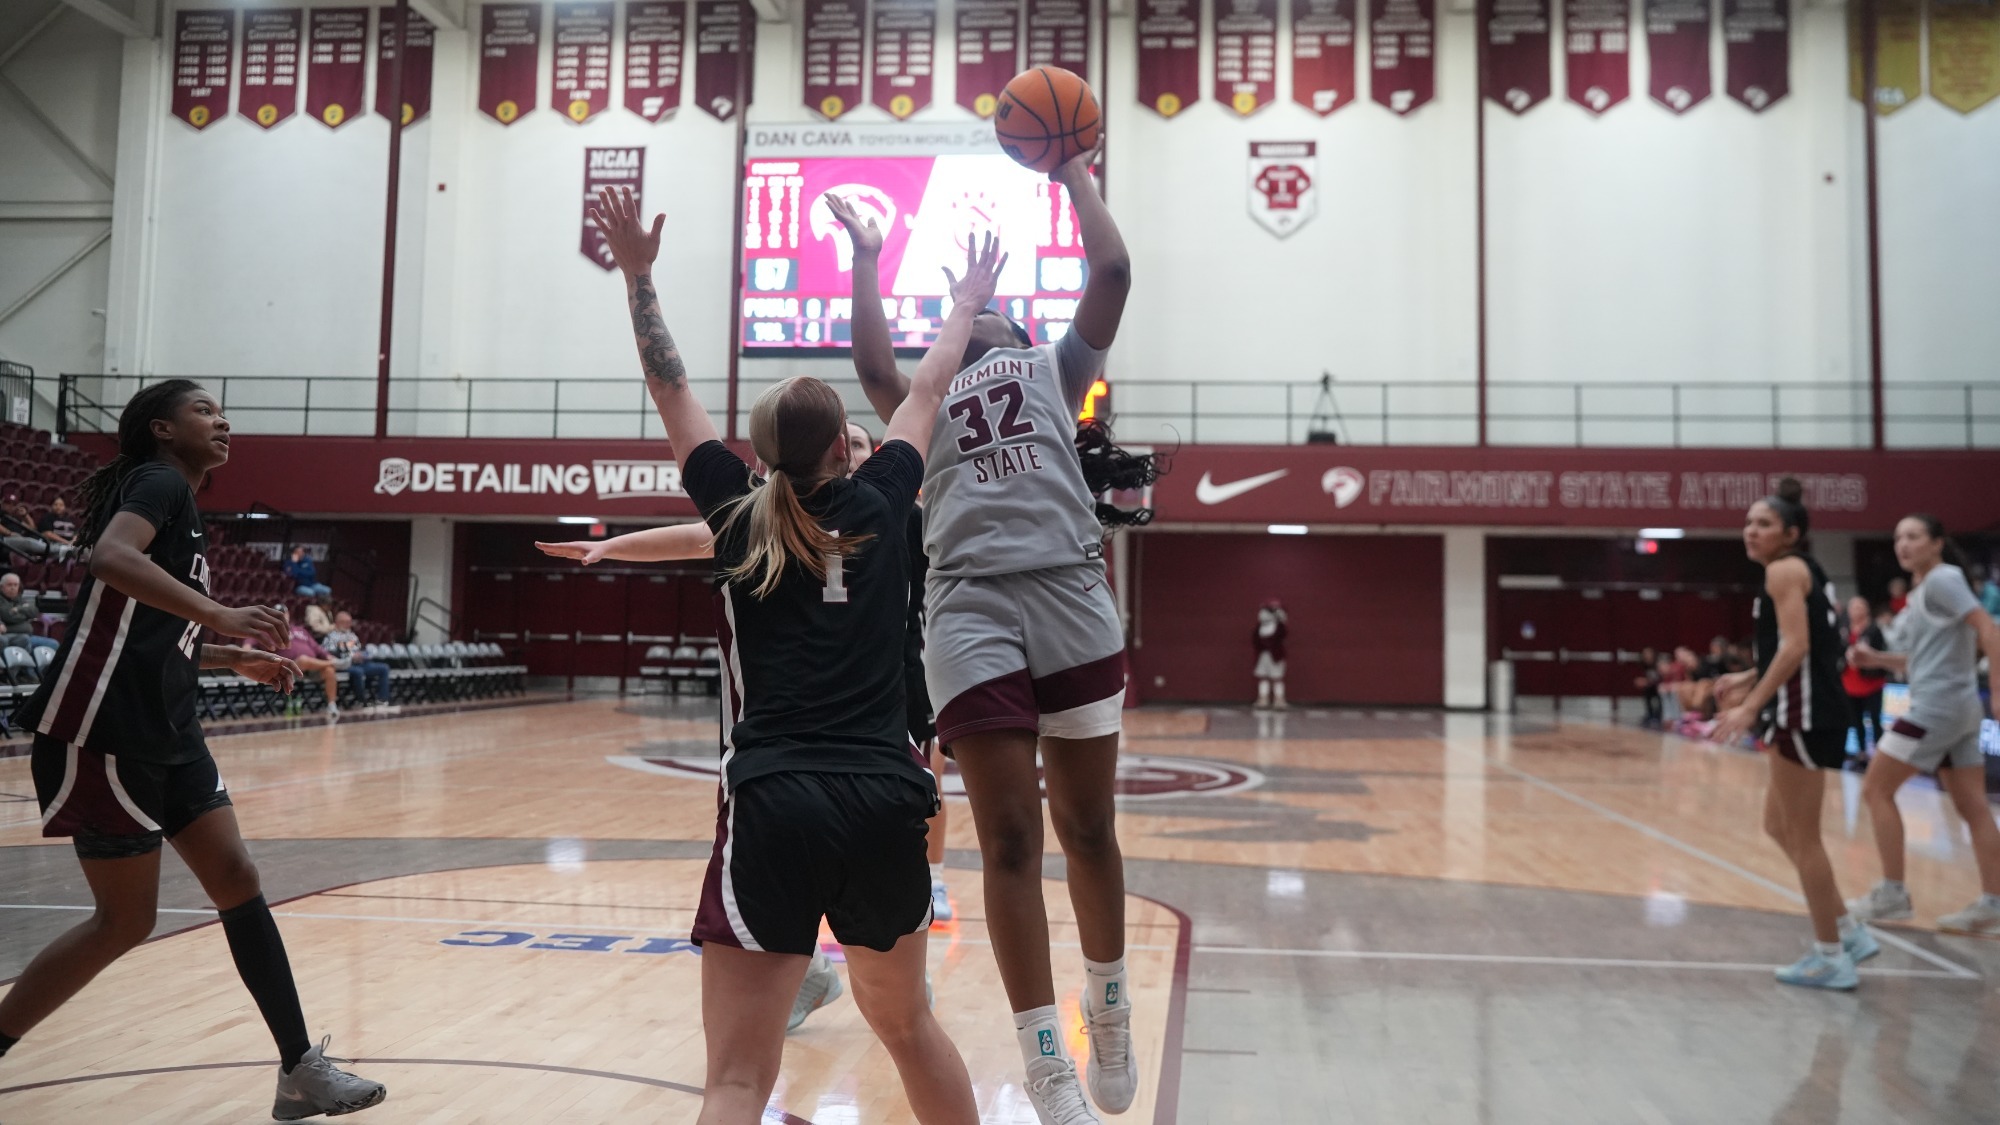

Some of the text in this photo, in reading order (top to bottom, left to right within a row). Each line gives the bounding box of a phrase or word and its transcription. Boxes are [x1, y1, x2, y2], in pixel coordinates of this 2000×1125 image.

[755, 132, 796, 146] DAN
[802, 132, 853, 146] CAVA
[589, 150, 639, 168] NCAA
[946, 360, 1037, 397] IRMONT
[948, 379, 1037, 454] 32
[412, 463, 683, 496] DETAILING WOR
[973, 444, 1042, 485] STATE
[1369, 470, 1553, 508] FAIRMONT
[1559, 470, 1672, 508] STATE
[822, 529, 848, 603] 1
